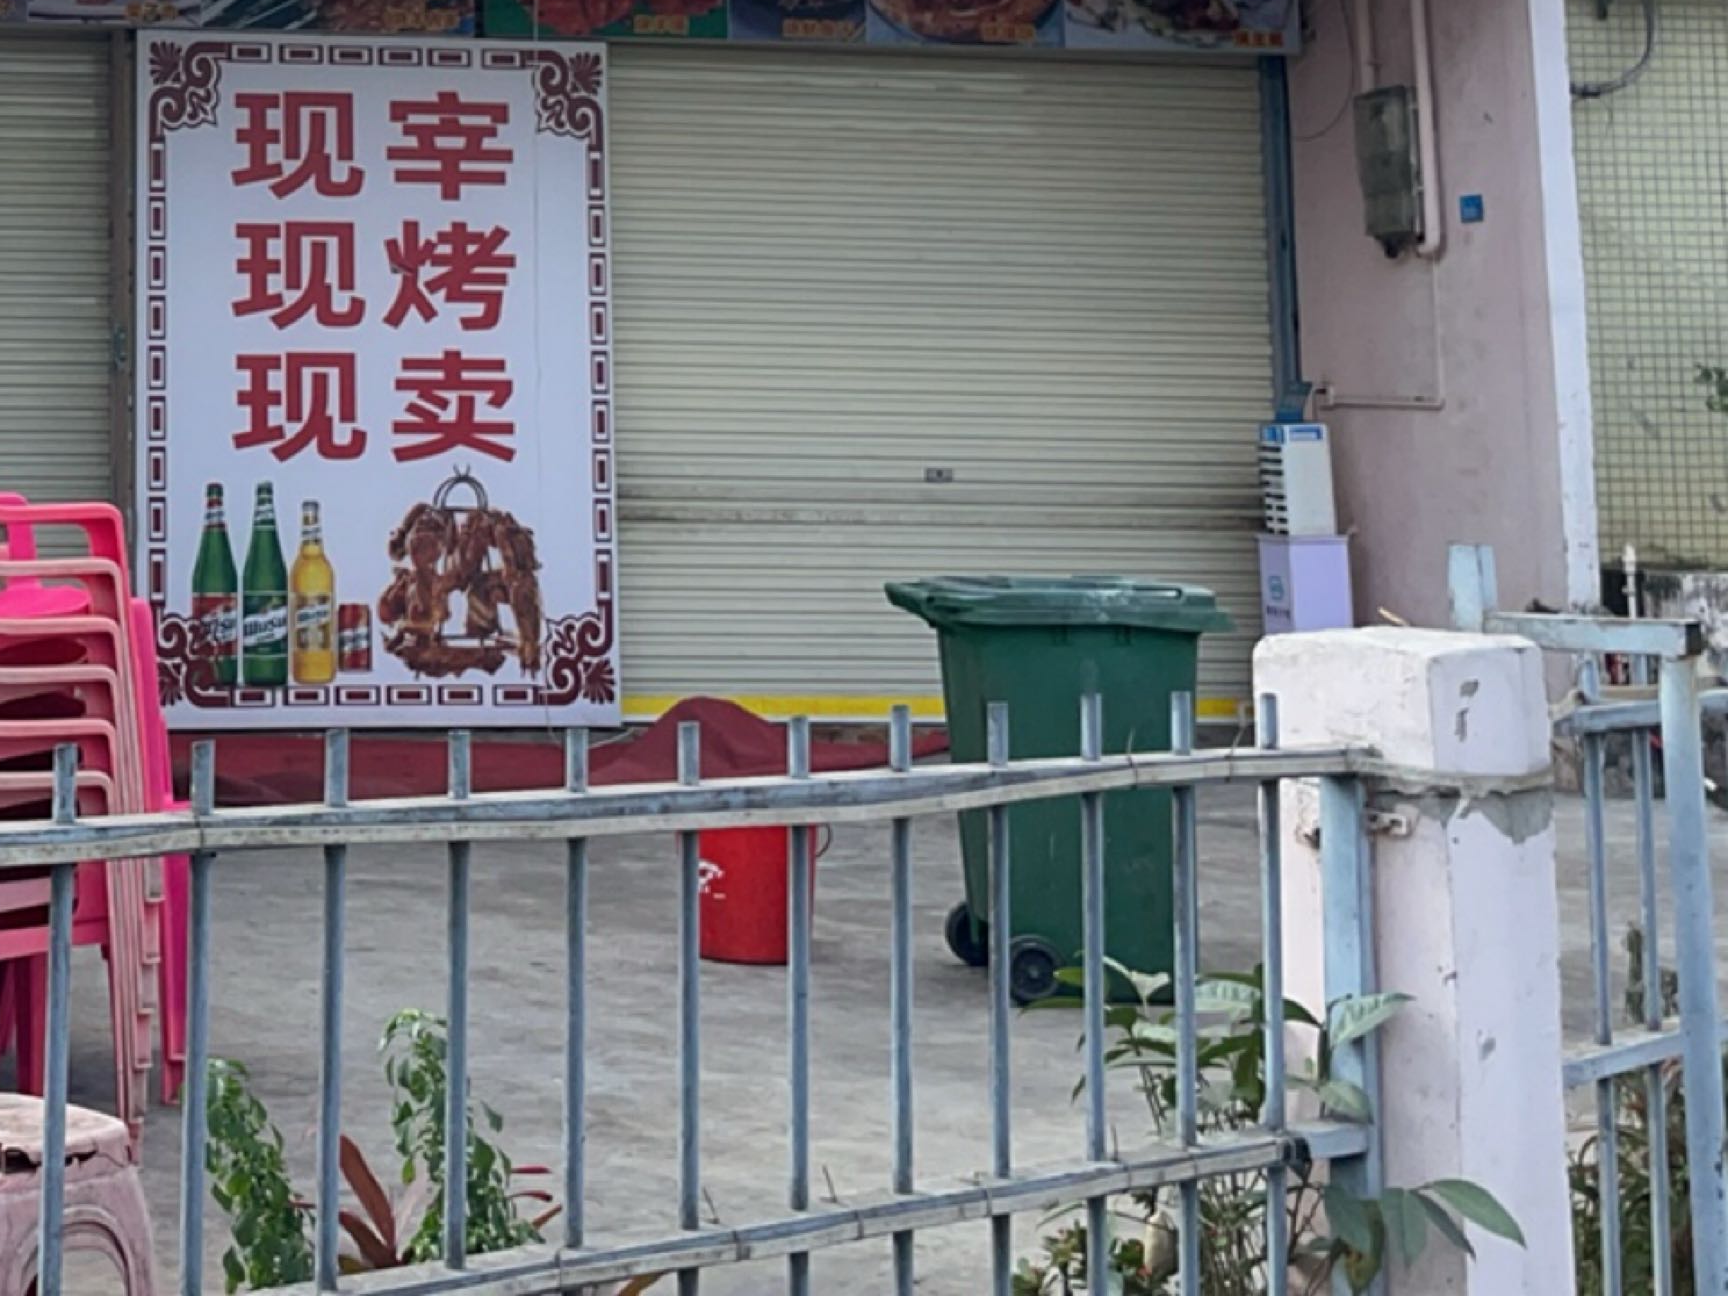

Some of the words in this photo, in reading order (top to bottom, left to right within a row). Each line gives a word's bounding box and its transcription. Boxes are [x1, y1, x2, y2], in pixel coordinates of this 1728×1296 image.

[232, 91, 514, 200] 现宰
[232, 220, 517, 331] 现烤
[232, 350, 517, 464] 现卖
